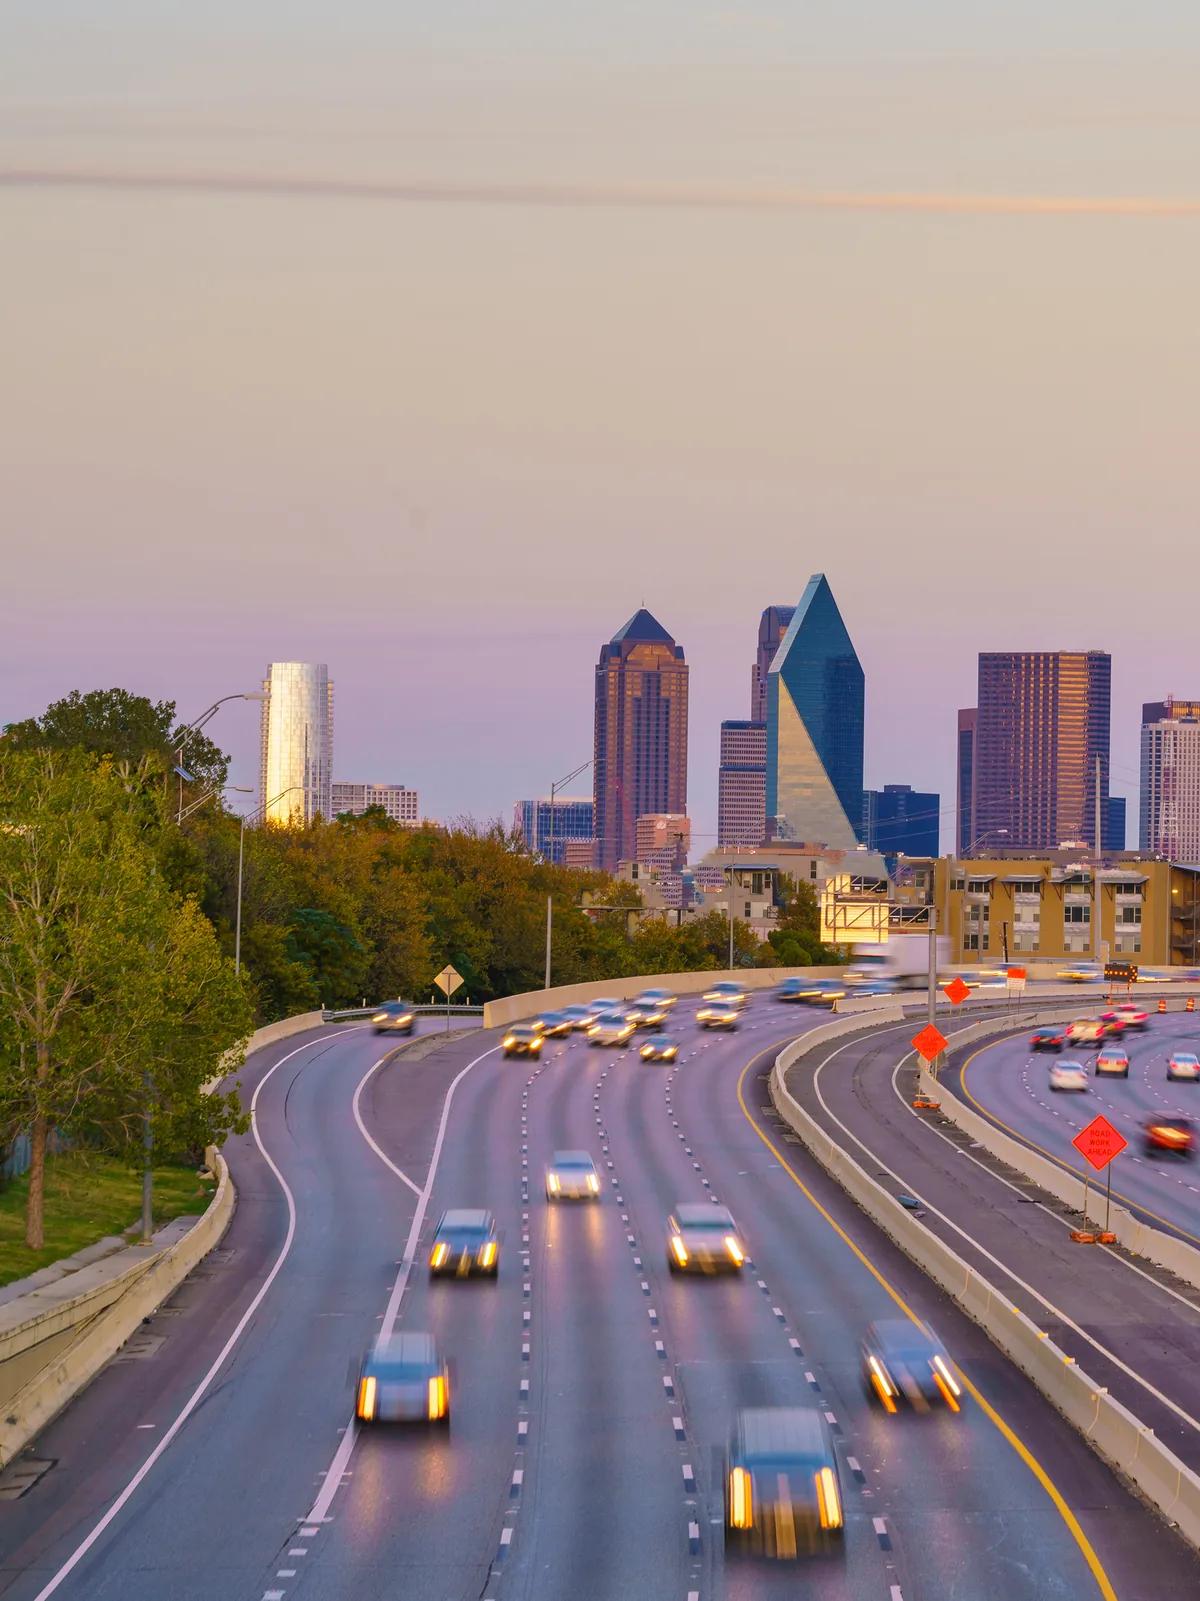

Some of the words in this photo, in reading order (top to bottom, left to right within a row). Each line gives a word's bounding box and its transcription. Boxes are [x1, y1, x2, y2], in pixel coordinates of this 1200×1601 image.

[1090, 1129, 1111, 1138] ROAD
[1089, 1139, 1111, 1147] WORK
[1087, 1148, 1113, 1156] AHEAD
